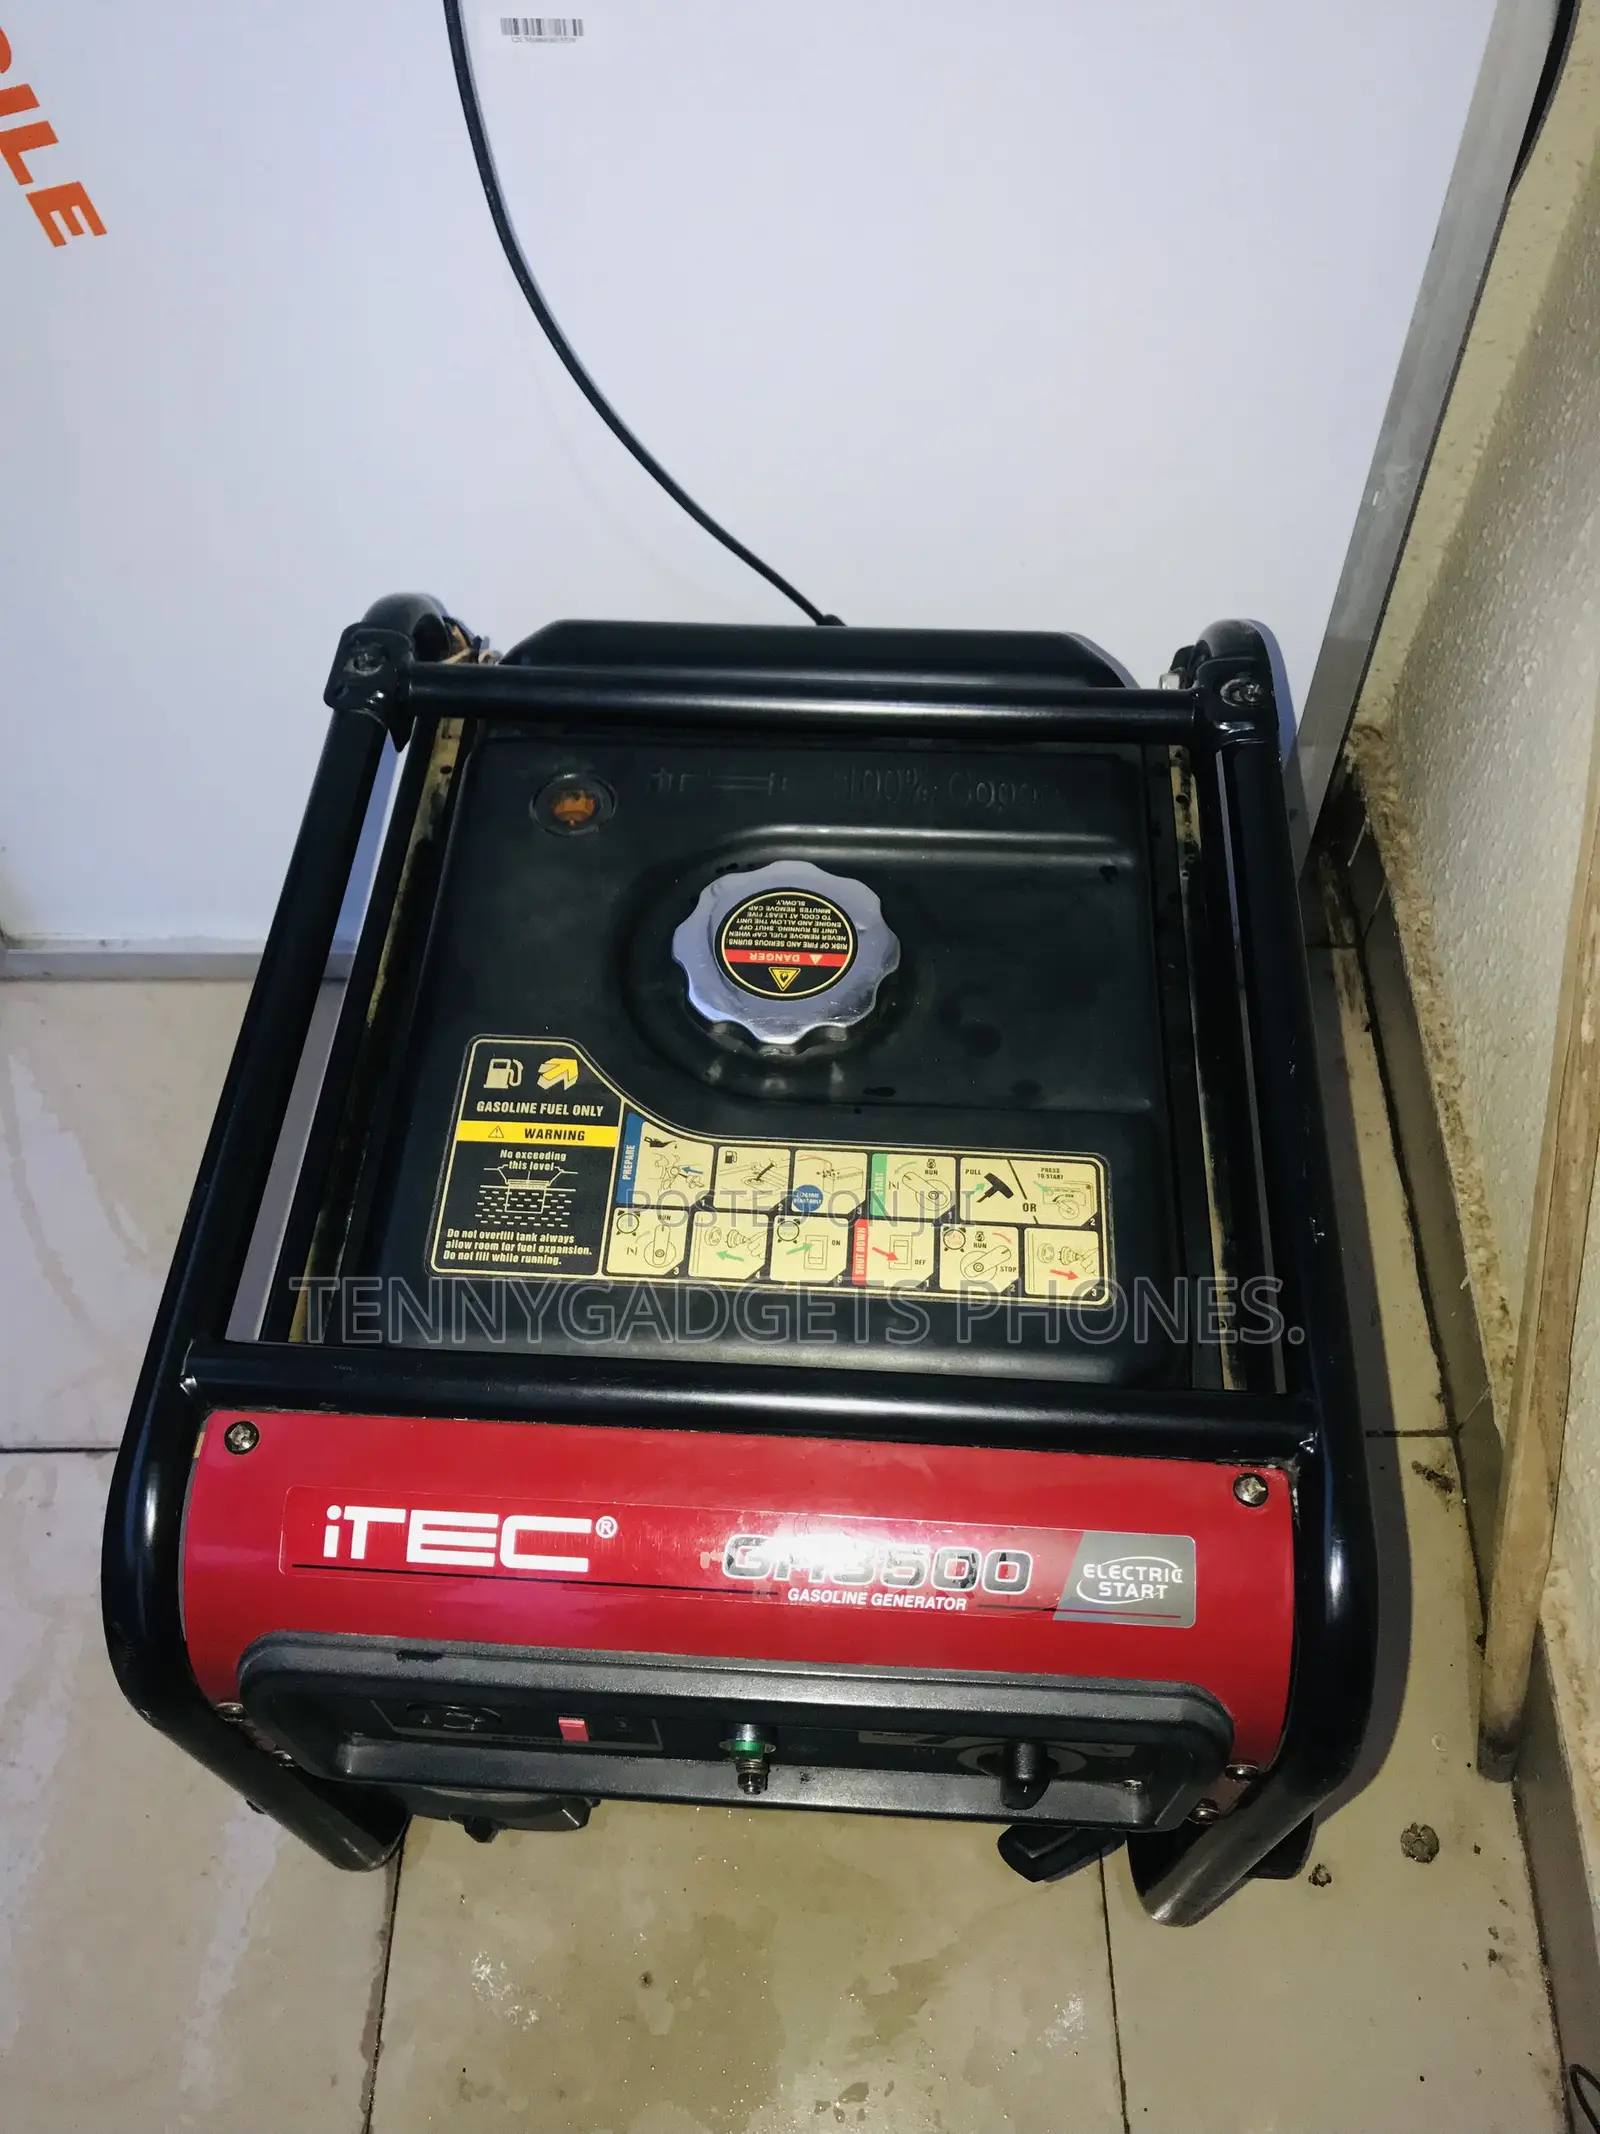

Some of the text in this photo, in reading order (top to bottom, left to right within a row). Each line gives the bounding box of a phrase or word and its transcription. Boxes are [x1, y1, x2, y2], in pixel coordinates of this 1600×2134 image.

[814, 920, 842, 928] ENGINE
[786, 940, 802, 948] AND
[831, 942, 848, 950] RISK
[750, 952, 800, 962] DANGER
[476, 1101, 603, 1117] GASOLINE FUEL ONLY
[524, 1128, 586, 1141] WARNING
[500, 1150, 566, 1162] No exceeding
[622, 1145, 635, 1180] PREPARE
[508, 1161, 554, 1171] this level
[874, 1173, 884, 1196] START
[1022, 1203, 1037, 1213] OR
[1090, 1218, 1096, 1226] 2
[447, 1228, 574, 1244] Do not overfill tank always
[446, 1240, 592, 1256] allow room for fuel expansion.
[855, 1228, 866, 1275] SHUT DOWN
[443, 1250, 562, 1266] Do not fill while running.
[674, 1267, 680, 1275] 3
[1010, 1284, 1016, 1292] 2
[1083, 1563, 1183, 1583] ELECTRIC
[1098, 1582, 1168, 1600] START
[787, 1588, 967, 1611] GASOLINE GENERATOR
